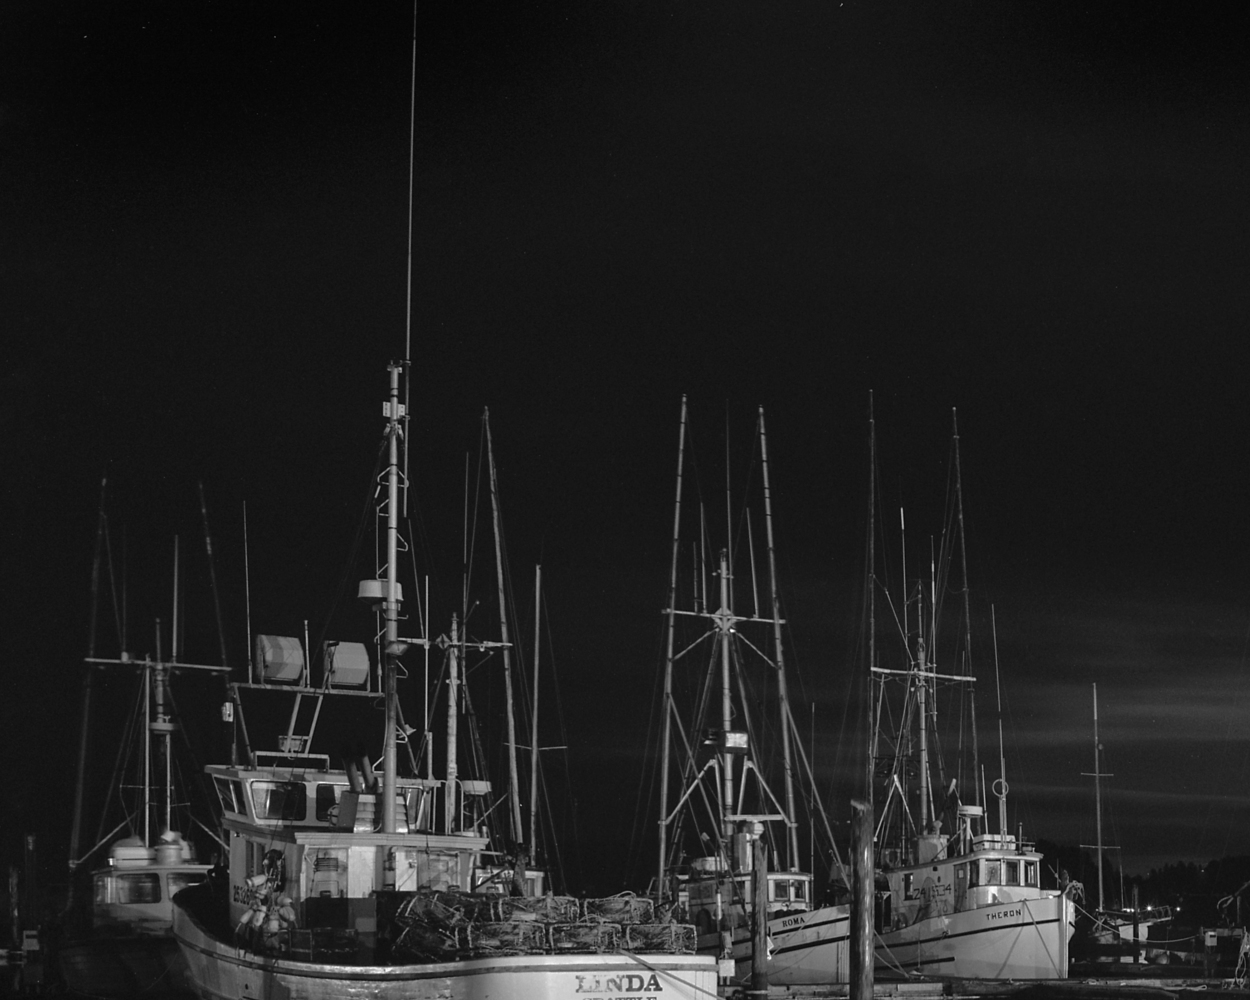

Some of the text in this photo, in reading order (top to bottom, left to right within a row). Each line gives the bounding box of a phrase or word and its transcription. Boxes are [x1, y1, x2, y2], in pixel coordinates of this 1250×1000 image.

[986, 909, 1022, 920] THERON
[782, 917, 805, 927] ROMA
[575, 973, 663, 993] LINDA
